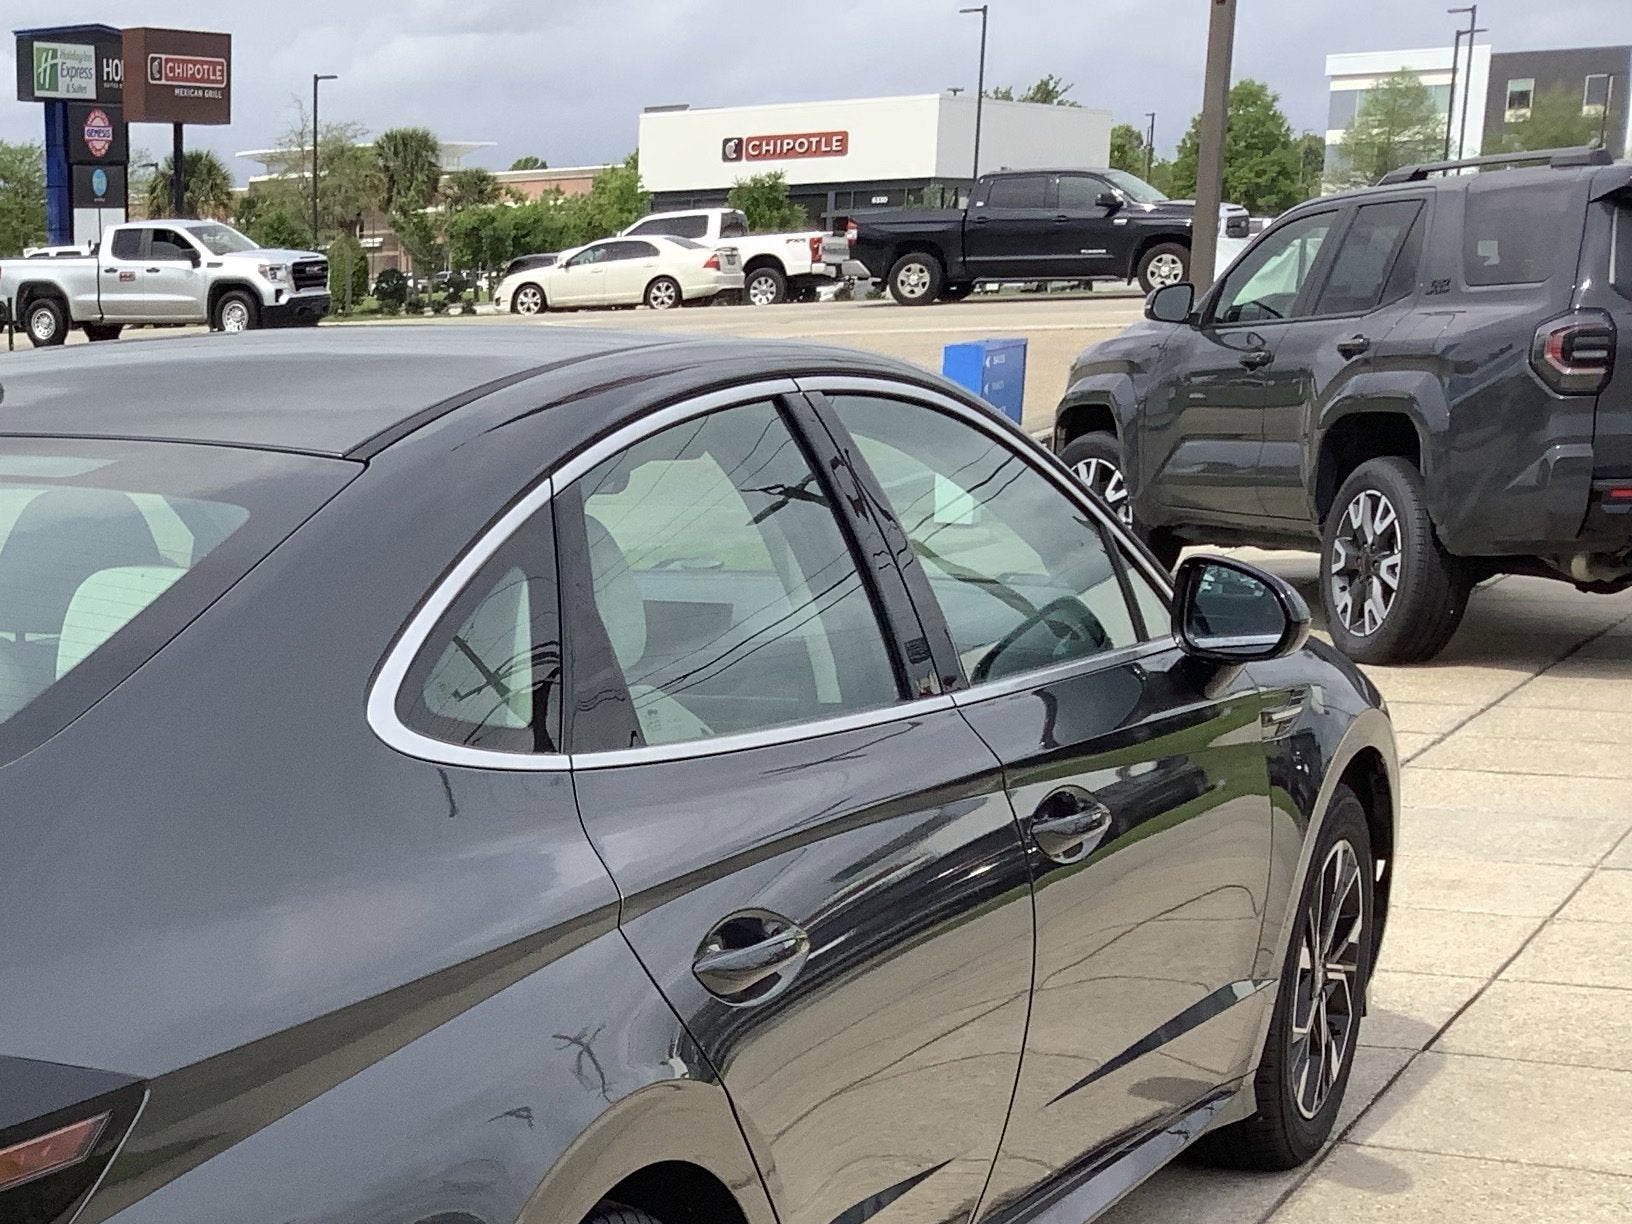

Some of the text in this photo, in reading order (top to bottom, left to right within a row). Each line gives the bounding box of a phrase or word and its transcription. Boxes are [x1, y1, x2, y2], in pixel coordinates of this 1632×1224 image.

[60, 62, 93, 81] Express
[166, 62, 223, 80] CHIPOTLE
[174, 88, 222, 99] MEXICAN GRILL
[86, 128, 111, 138] GENESIS
[748, 136, 843, 156] CHIPOTLE
